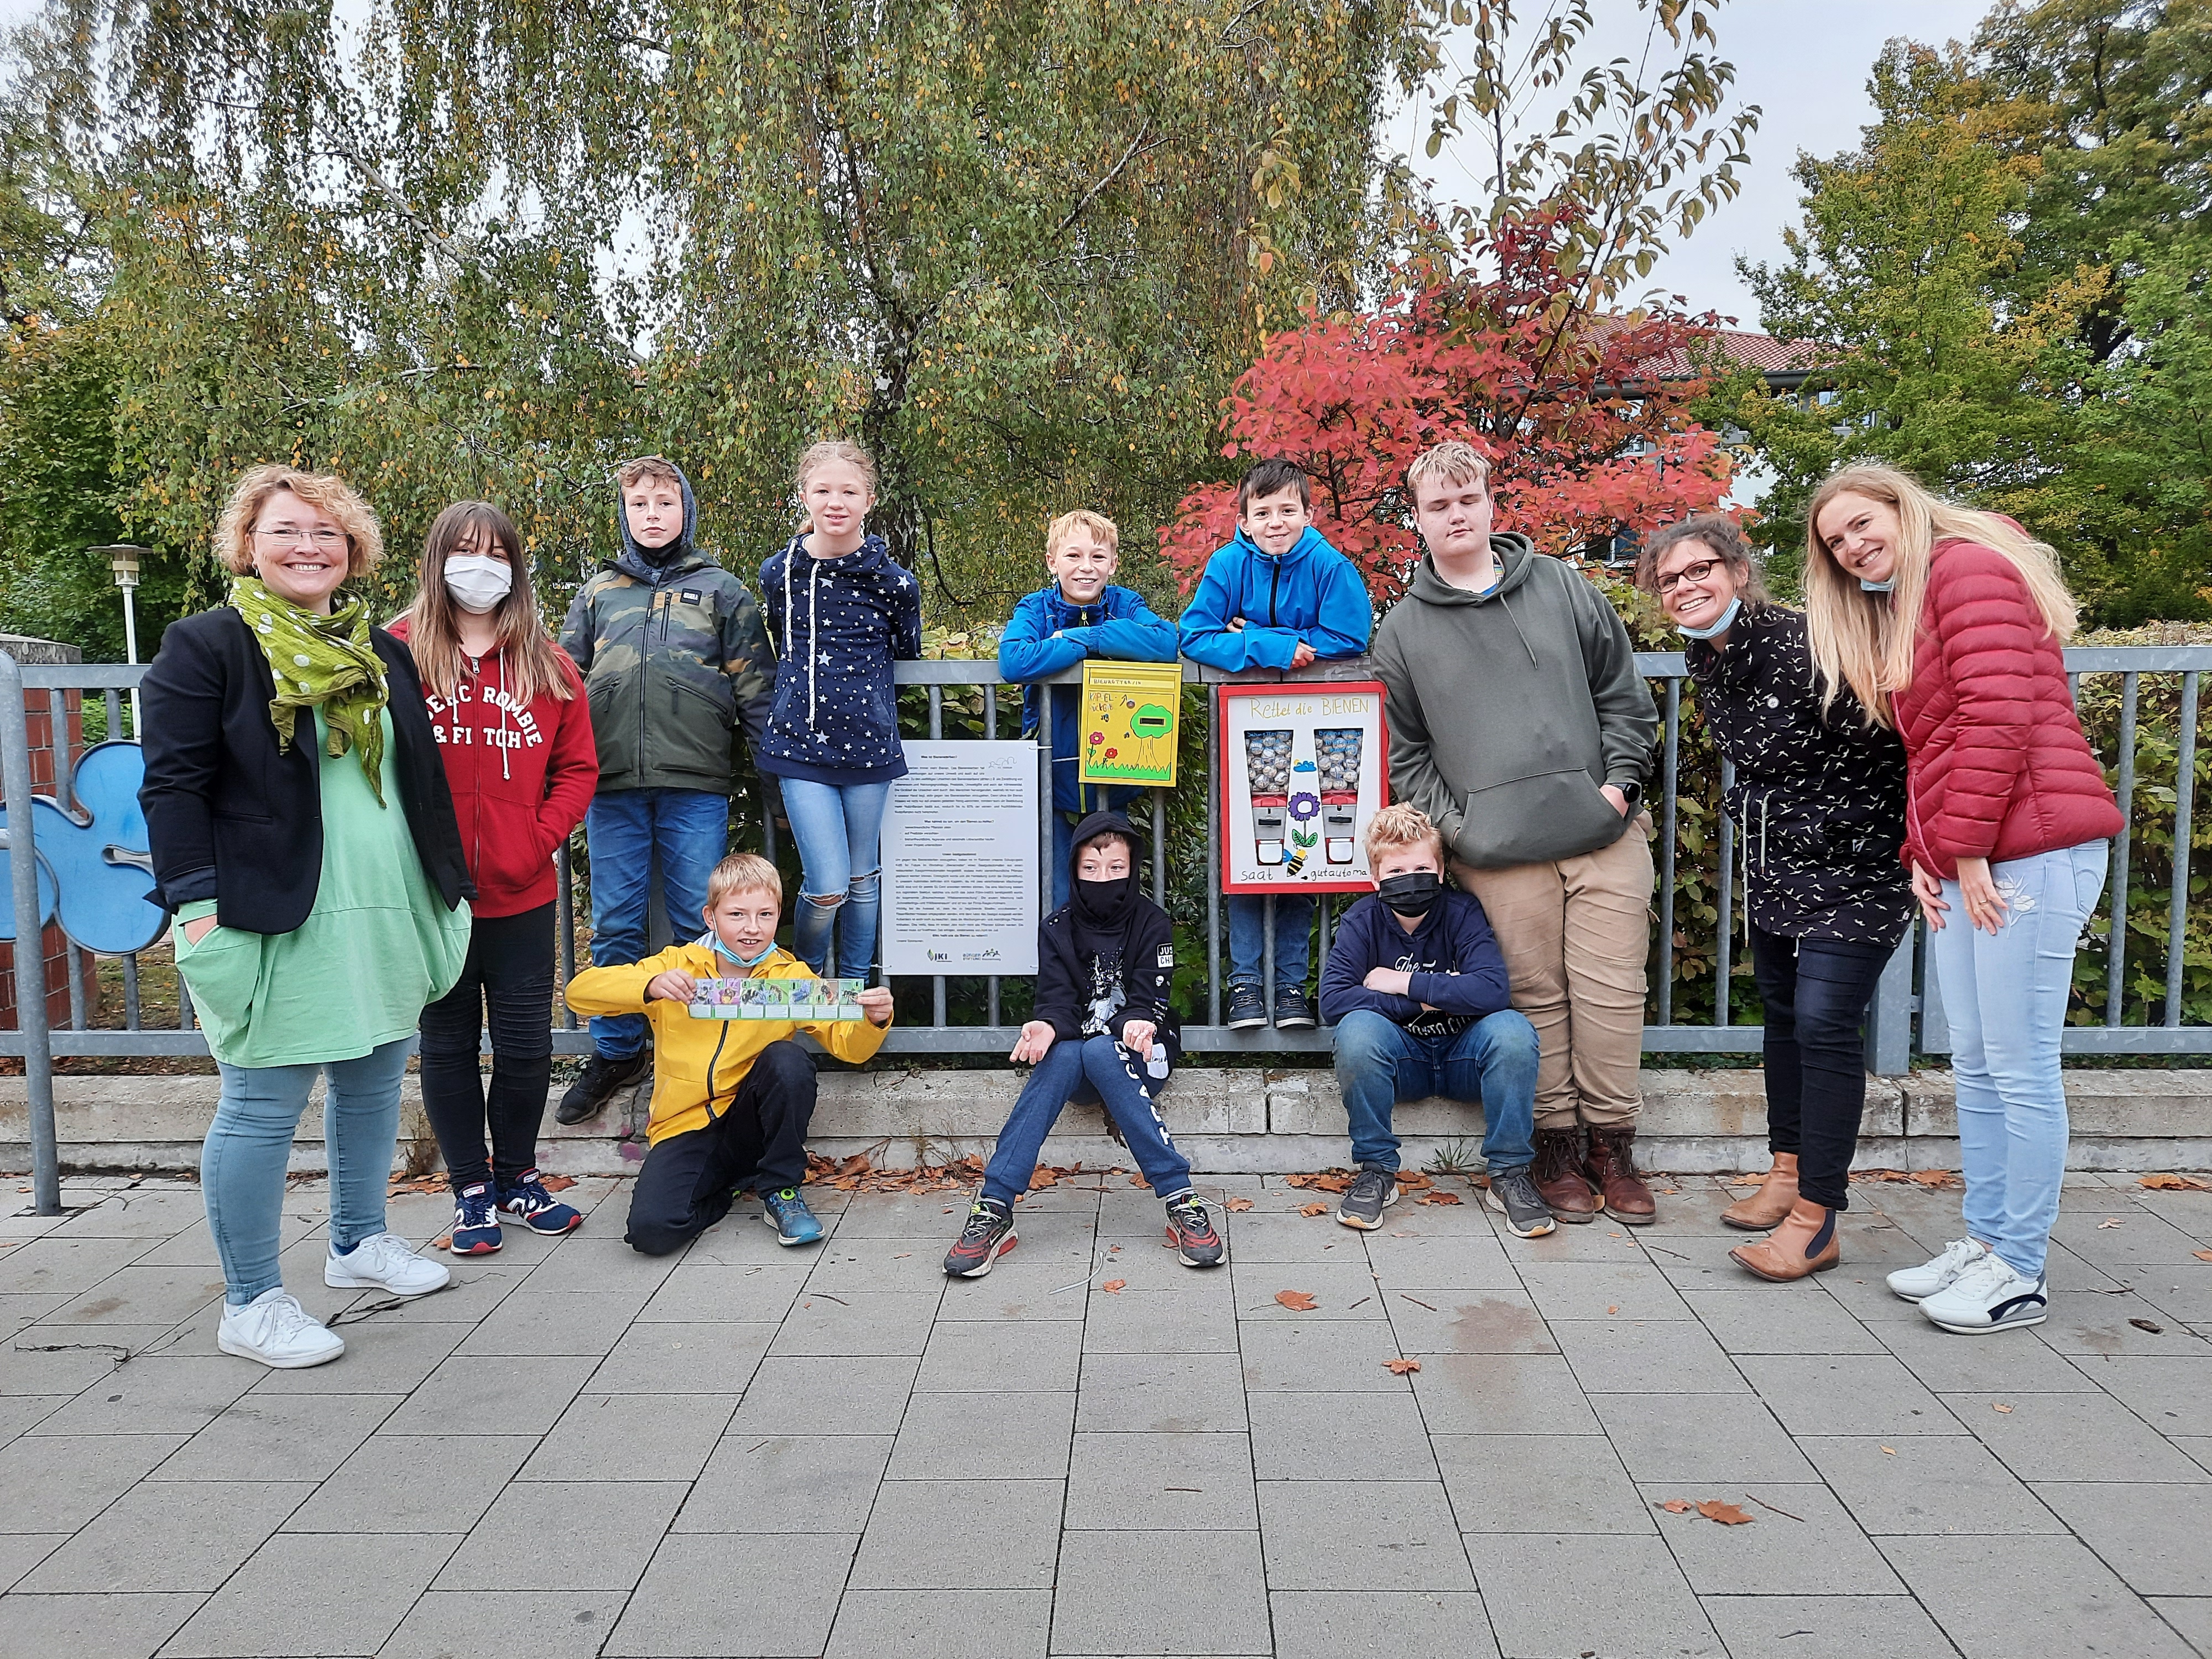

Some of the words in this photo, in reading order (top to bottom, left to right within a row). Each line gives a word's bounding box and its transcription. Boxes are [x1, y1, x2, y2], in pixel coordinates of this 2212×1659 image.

[1249, 697, 1291, 719] Rettet
[1295, 702, 1313, 716] die
[1321, 697, 1369, 717] BIENEN
[1240, 867, 1274, 881] saat
[1310, 867, 1370, 881] gutautoma
[935, 953, 947, 961] JKI
[1395, 952, 1421, 973] The
